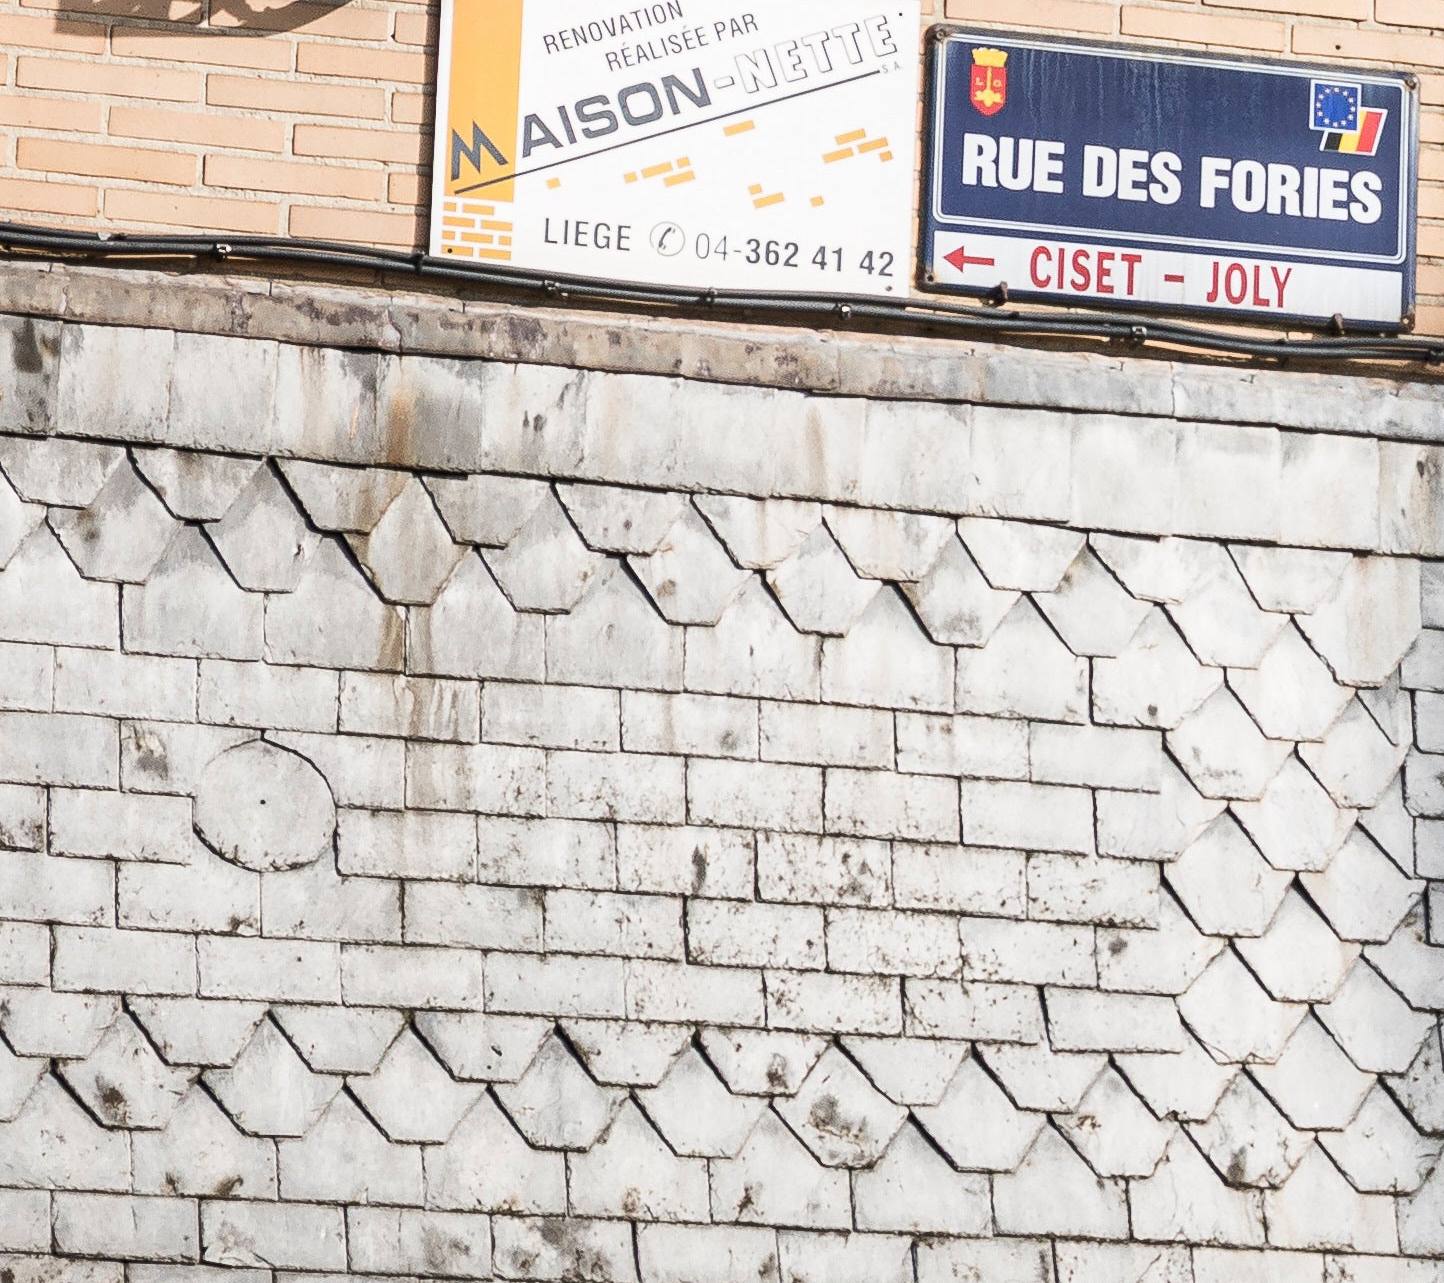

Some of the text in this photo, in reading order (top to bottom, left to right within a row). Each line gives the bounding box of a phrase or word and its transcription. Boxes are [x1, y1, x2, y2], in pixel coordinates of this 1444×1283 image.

[543, 0, 684, 55] RENOVATION
[606, 13, 760, 73] RÉALISÉE PAR
[962, 132, 1383, 225] RUE DES FORIES
[543, 218, 894, 277] LIEGE 04-362 41 42
[1030, 245, 1142, 296] CISET
[1206, 261, 1293, 309] JOLY
